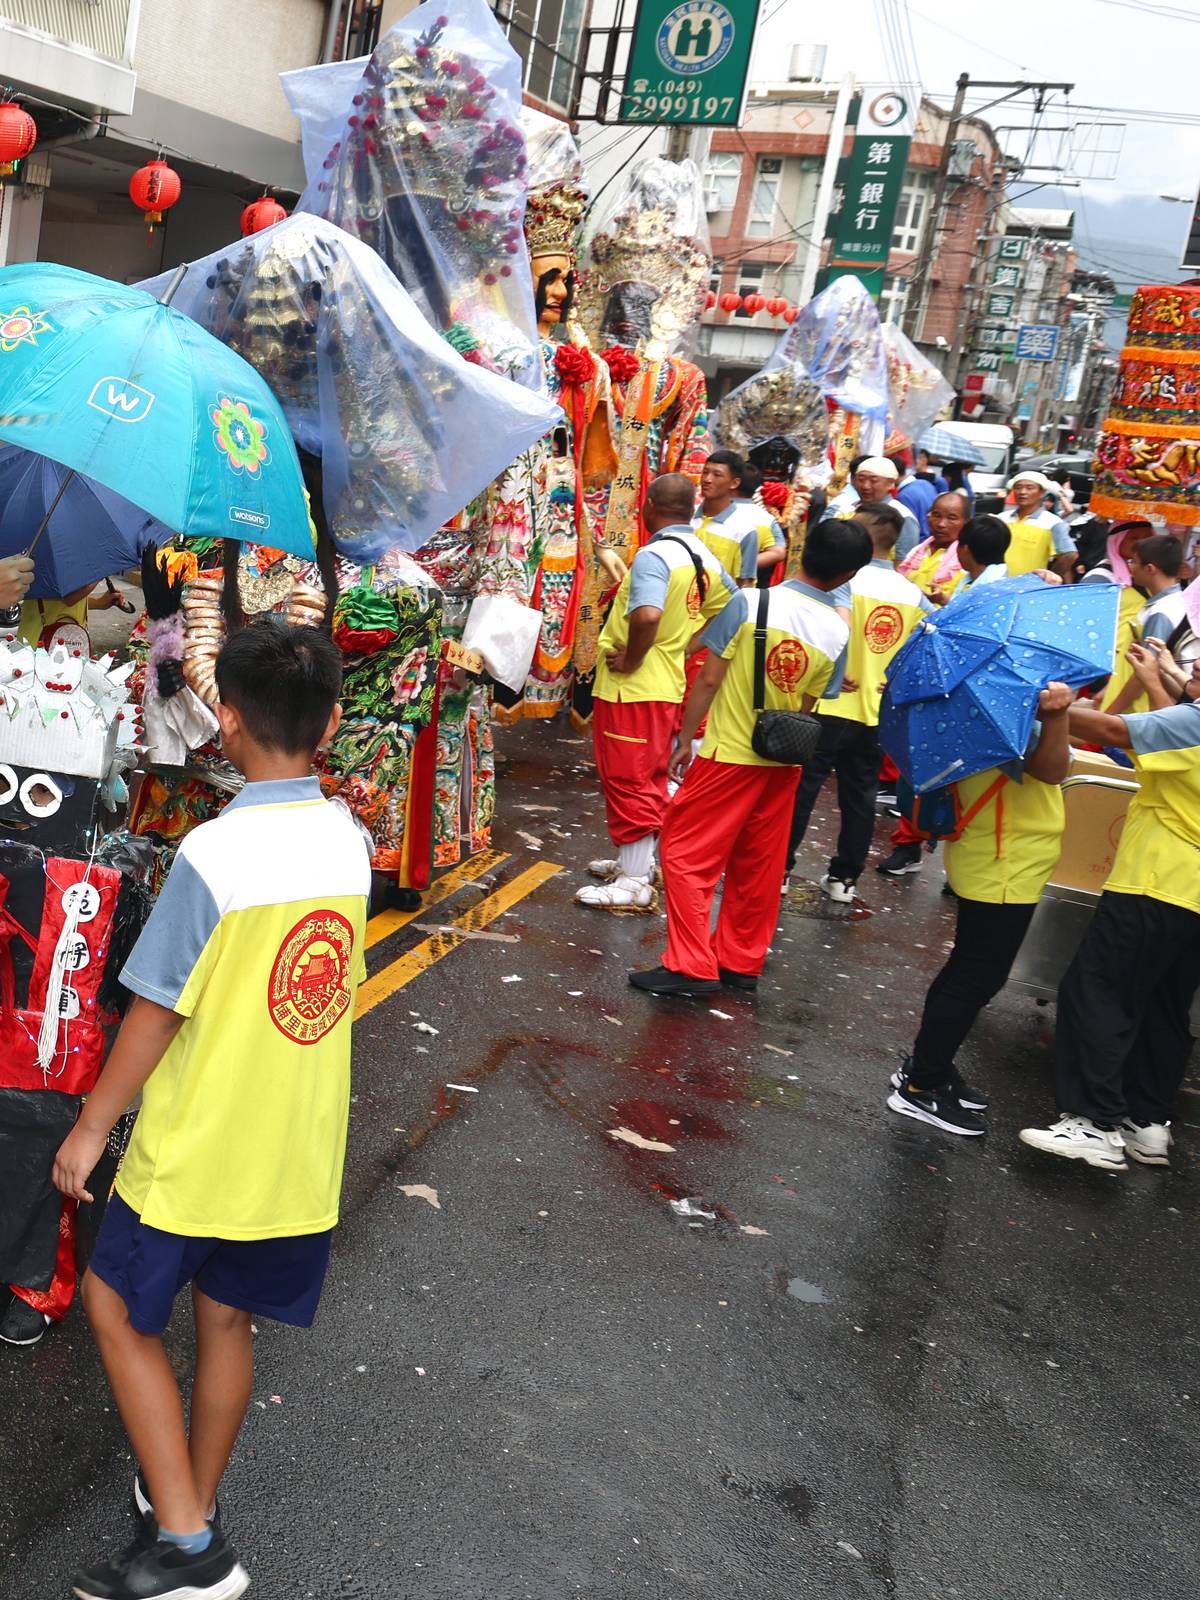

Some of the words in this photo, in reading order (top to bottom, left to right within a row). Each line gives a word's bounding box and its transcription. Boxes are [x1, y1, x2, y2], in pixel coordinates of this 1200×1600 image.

[627, 96, 735, 119] 2999197
[854, 141, 893, 231] 第一銀行
[1019, 327, 1055, 357] 藥
[234, 511, 265, 525] watsons
